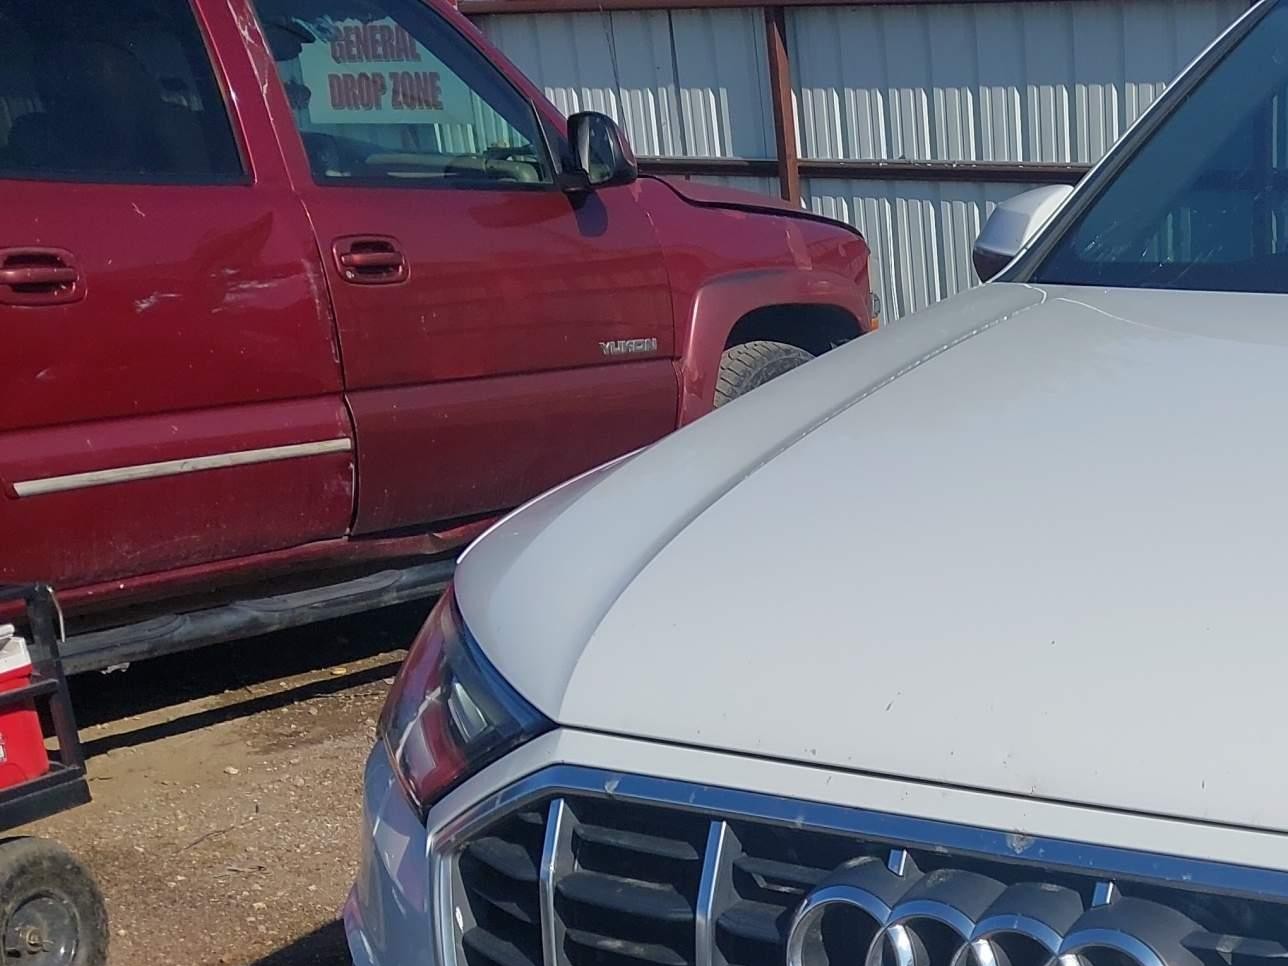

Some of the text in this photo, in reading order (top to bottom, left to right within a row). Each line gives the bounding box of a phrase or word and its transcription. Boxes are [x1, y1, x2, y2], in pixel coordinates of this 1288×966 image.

[331, 23, 422, 64] GENERAL
[328, 71, 444, 111] DROP ZONE
[598, 337, 658, 354] YUKON
